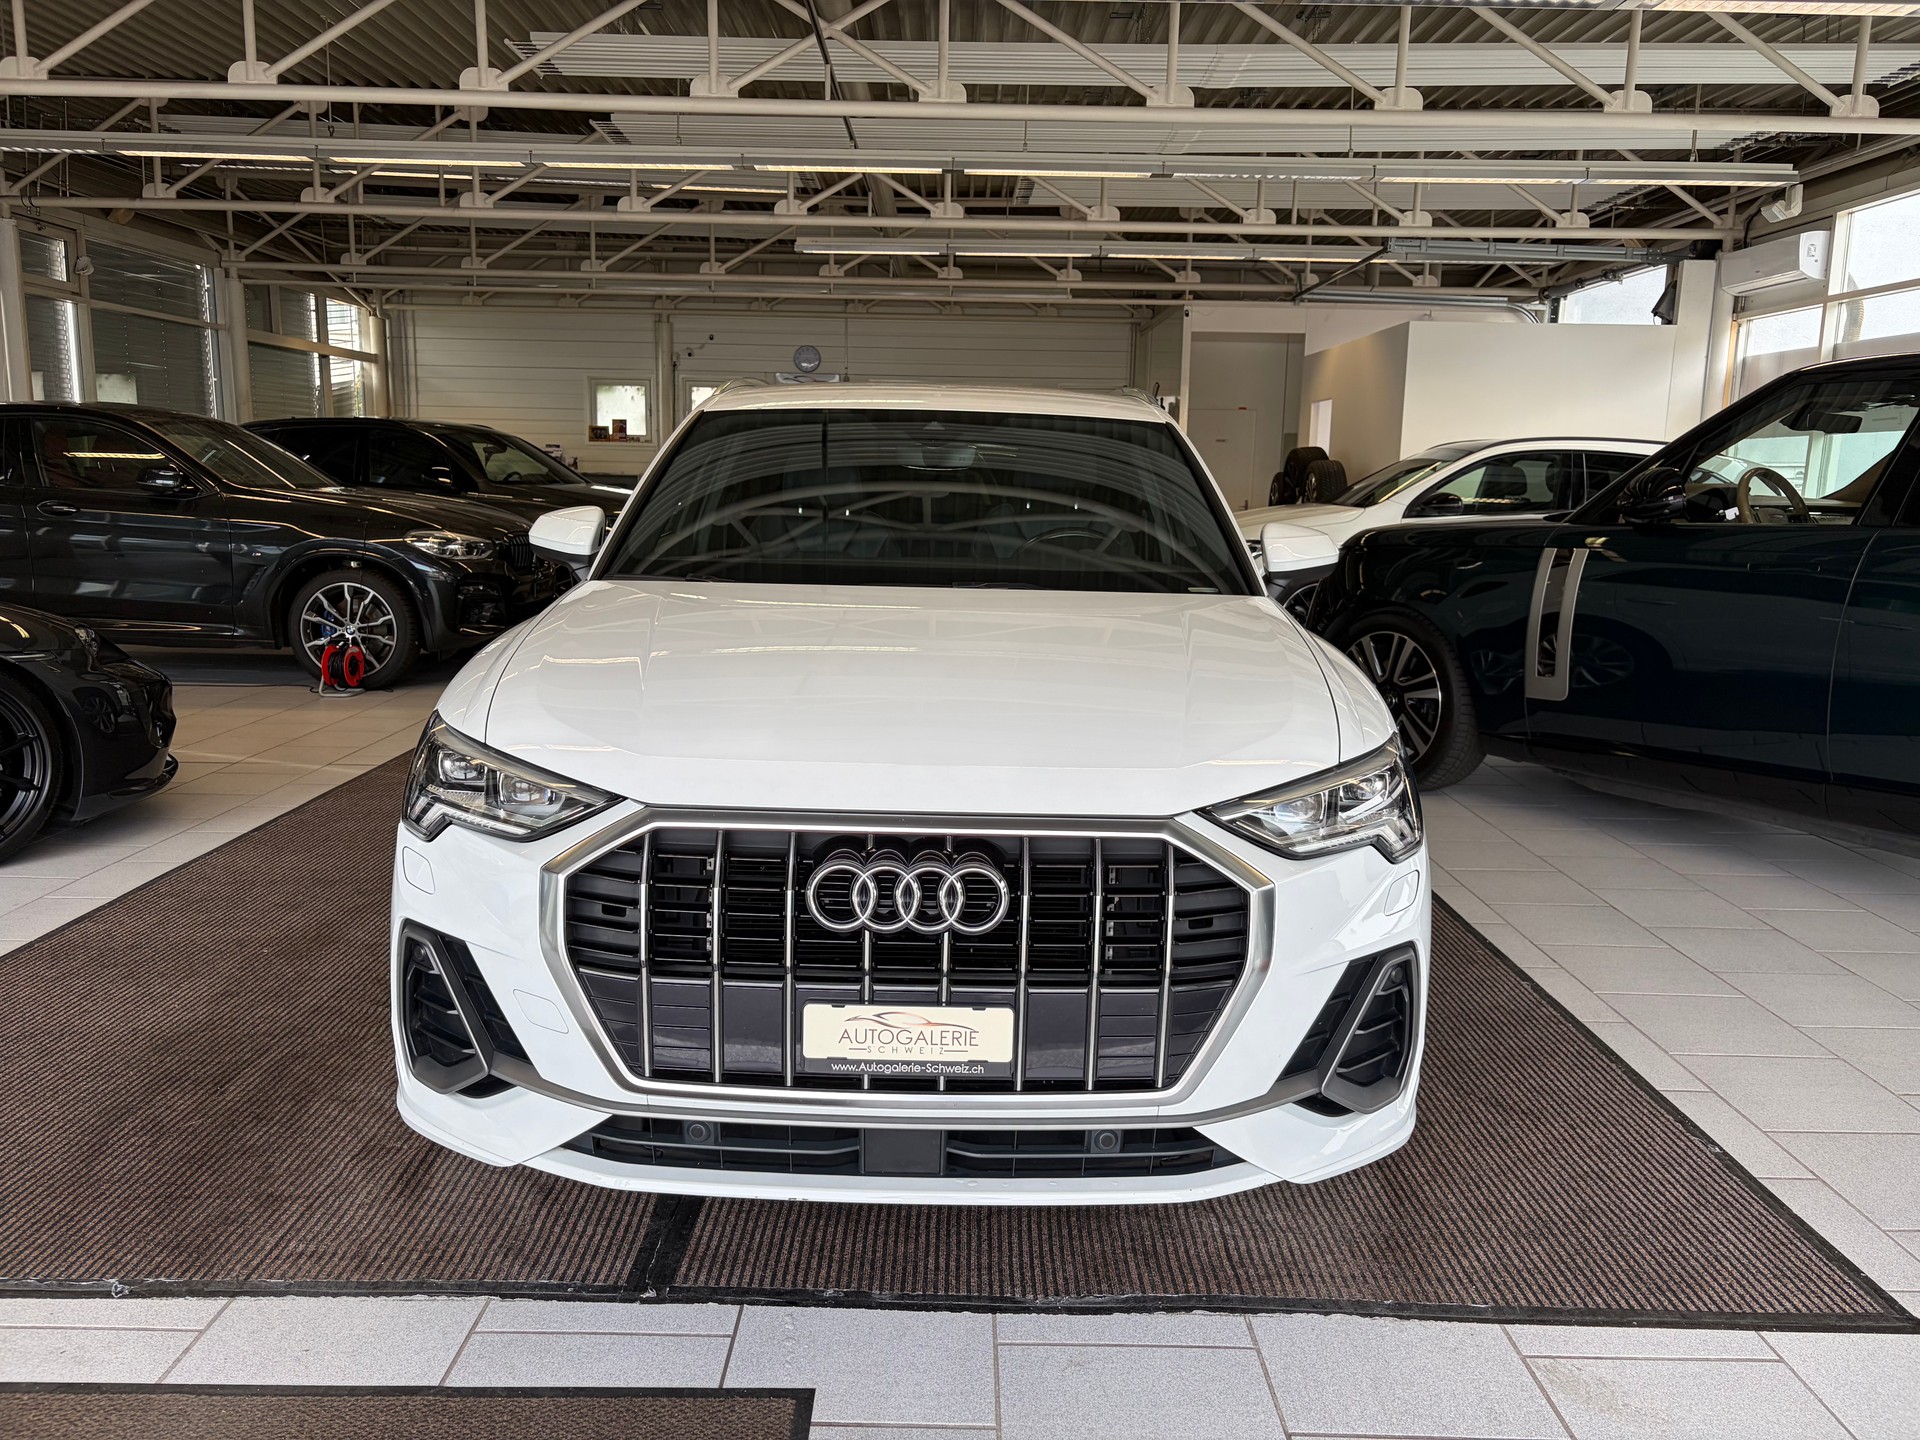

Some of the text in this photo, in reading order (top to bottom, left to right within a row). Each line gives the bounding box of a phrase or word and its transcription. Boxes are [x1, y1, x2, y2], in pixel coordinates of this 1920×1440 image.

[838, 1028, 980, 1047] AUTOGALERIE
[867, 1046, 945, 1055] SCHWEIZ
[831, 1062, 985, 1074] www.Autogalerie-Schweiz.ch
